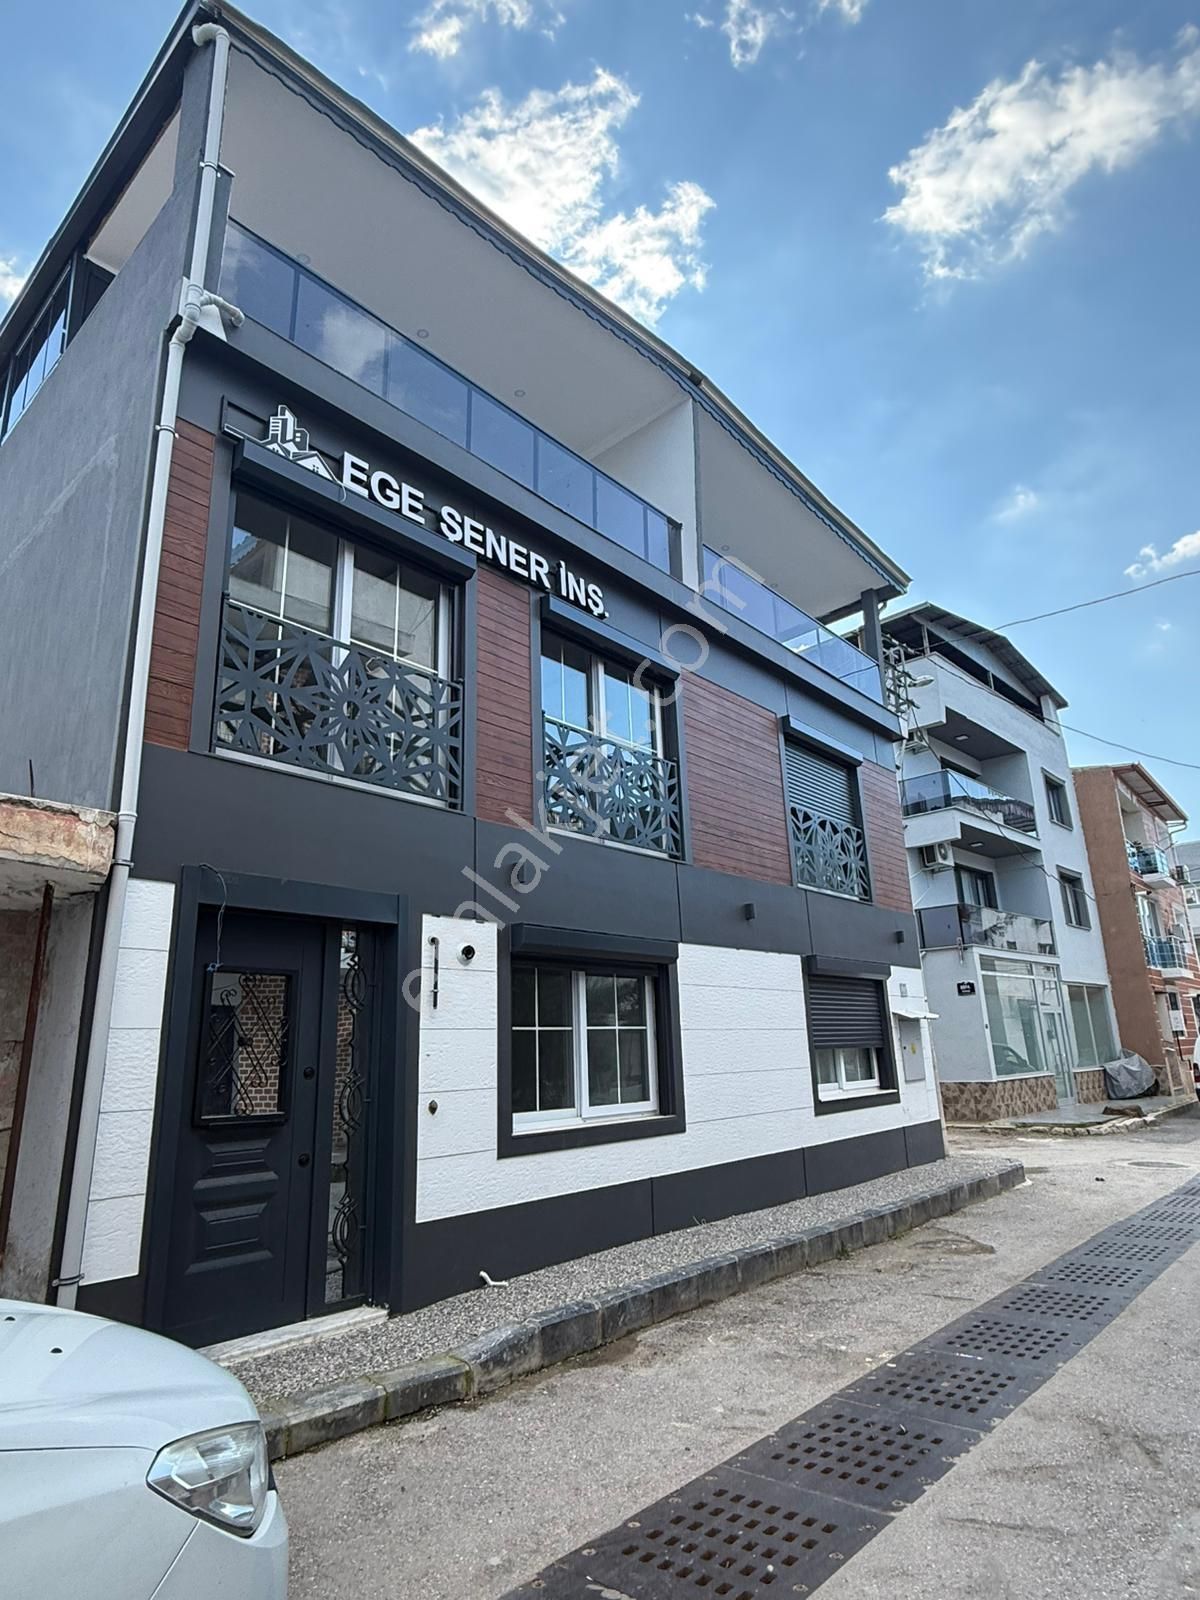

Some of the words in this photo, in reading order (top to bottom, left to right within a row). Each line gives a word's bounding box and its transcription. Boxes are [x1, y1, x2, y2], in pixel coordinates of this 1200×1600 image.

[342, 451, 425, 525] EGE
[440, 505, 551, 589] ŞENER
[559, 559, 610, 618] İNŞ.
